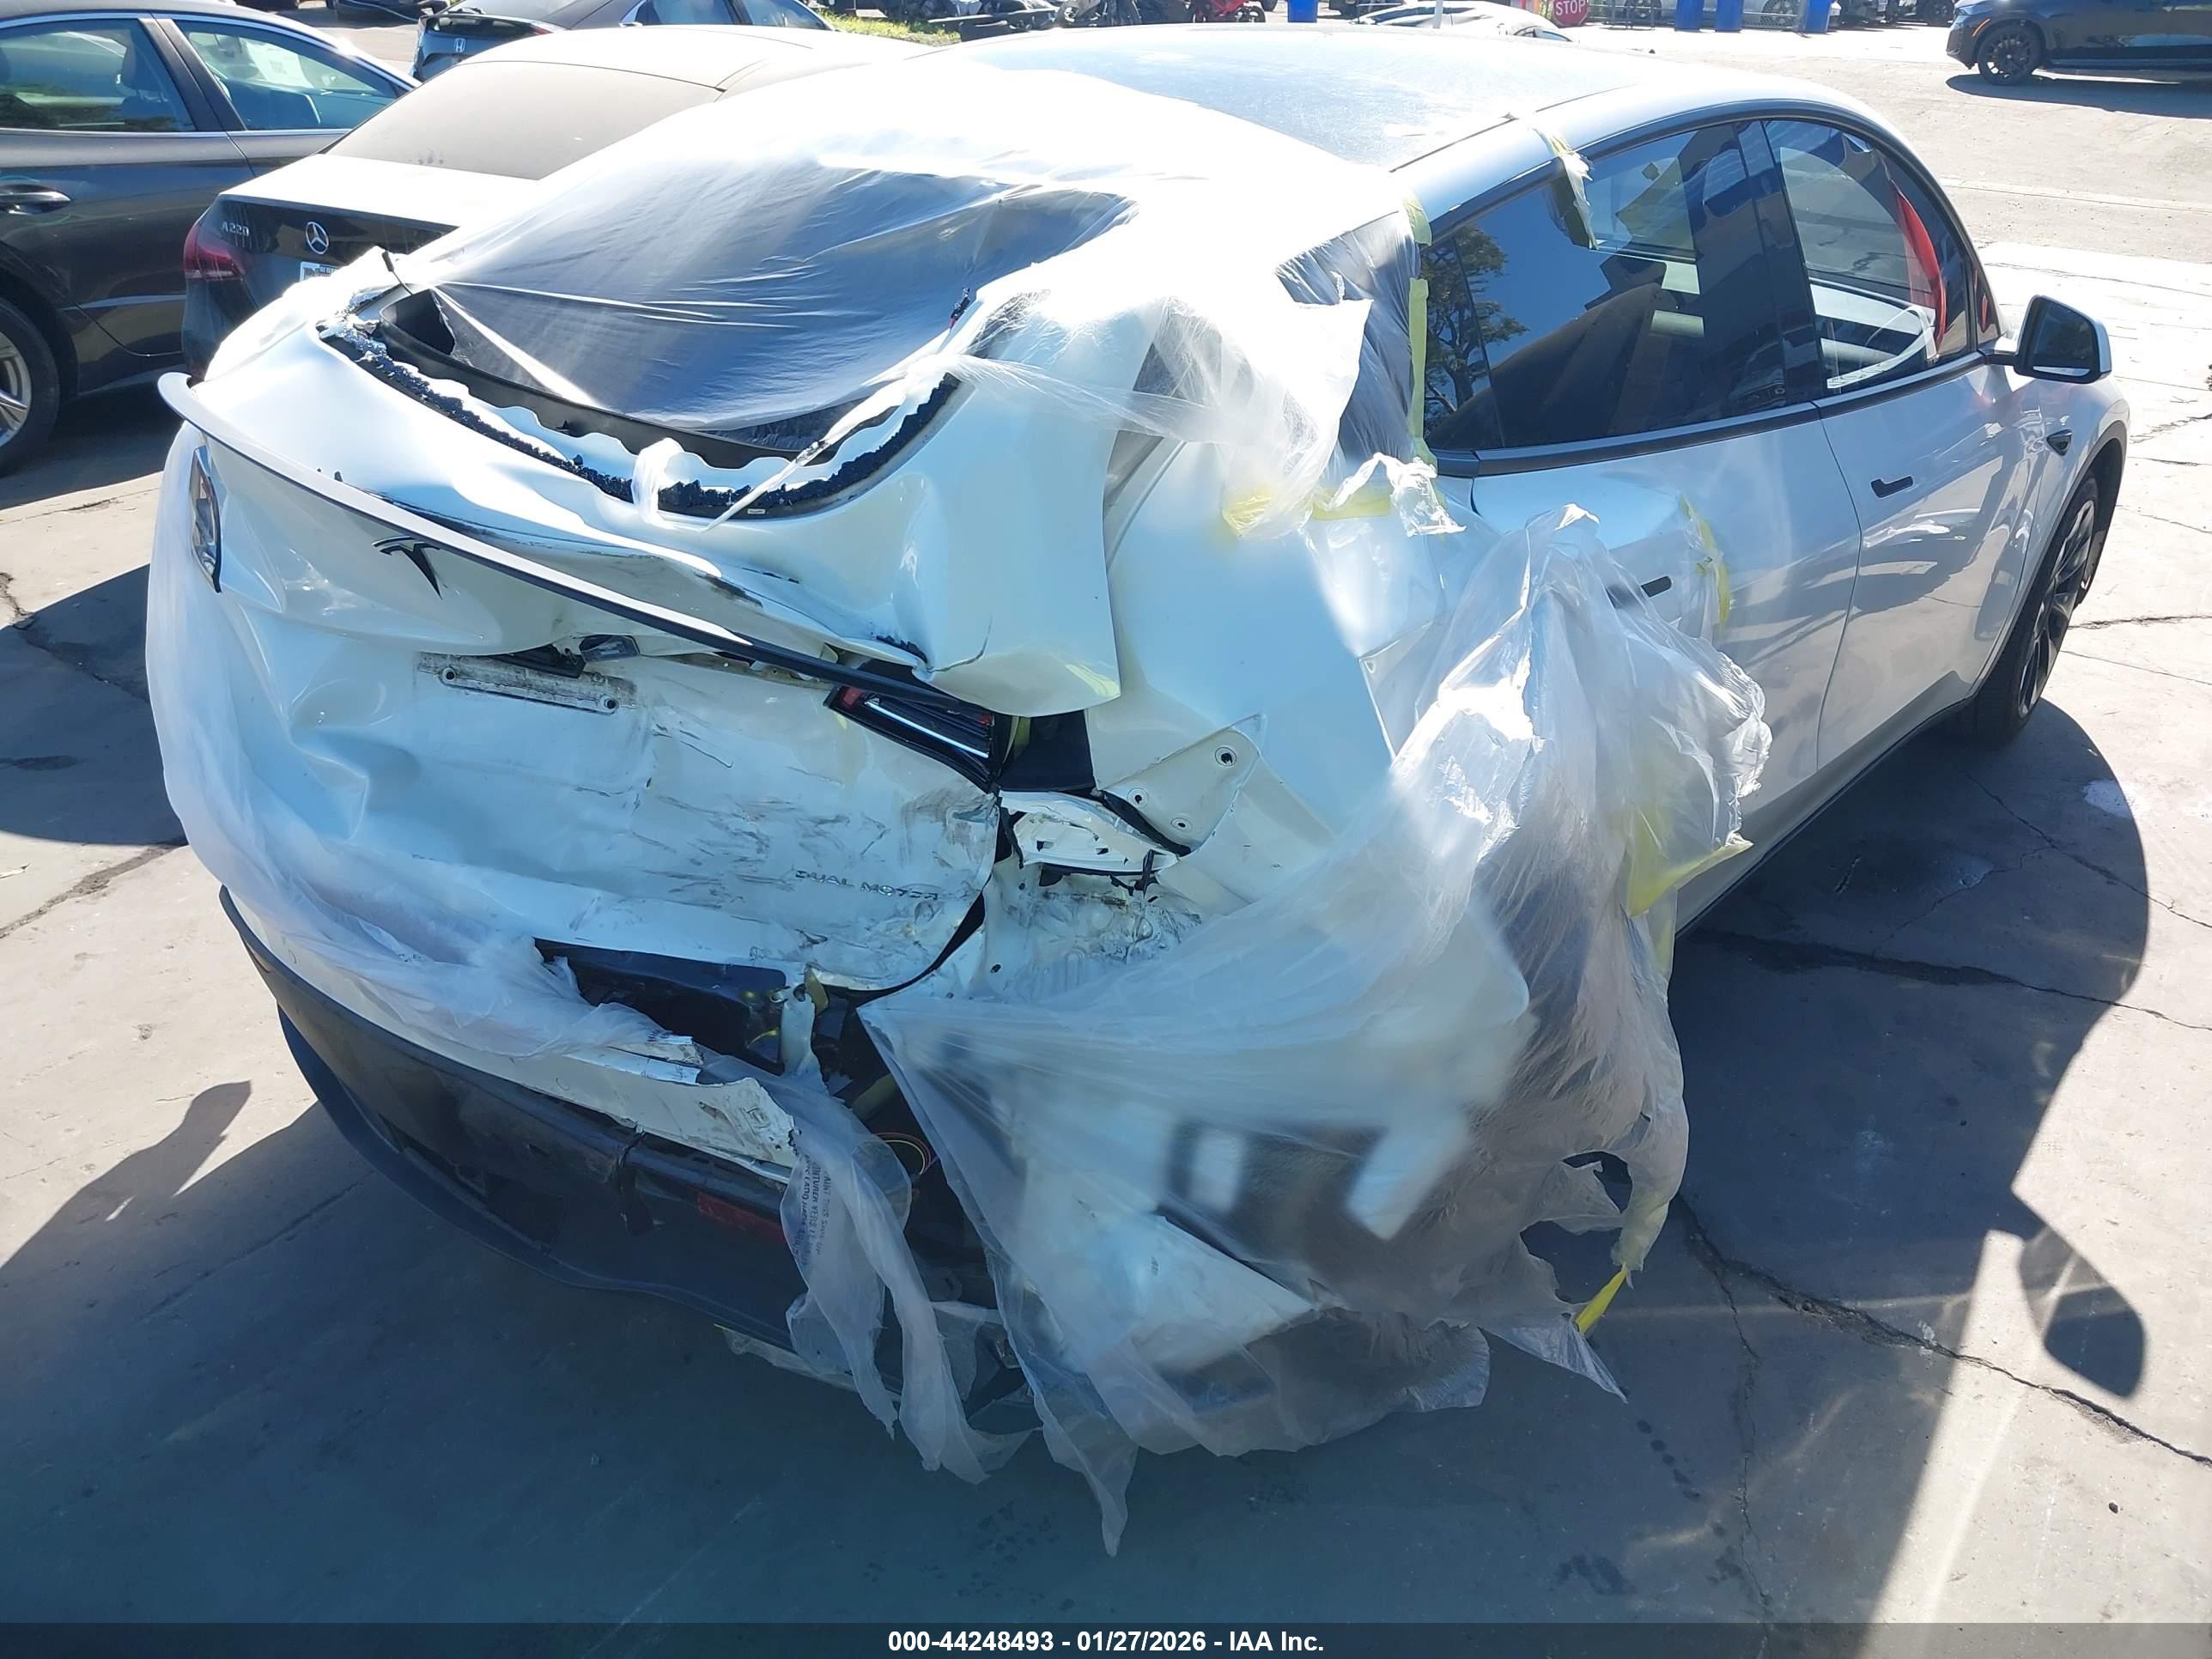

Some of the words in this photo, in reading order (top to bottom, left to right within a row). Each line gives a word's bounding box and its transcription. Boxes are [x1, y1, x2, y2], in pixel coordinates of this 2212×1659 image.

[1555, 0, 1586, 15] STOP
[795, 870, 856, 889] DUAL
[860, 880, 939, 901] MOTOR
